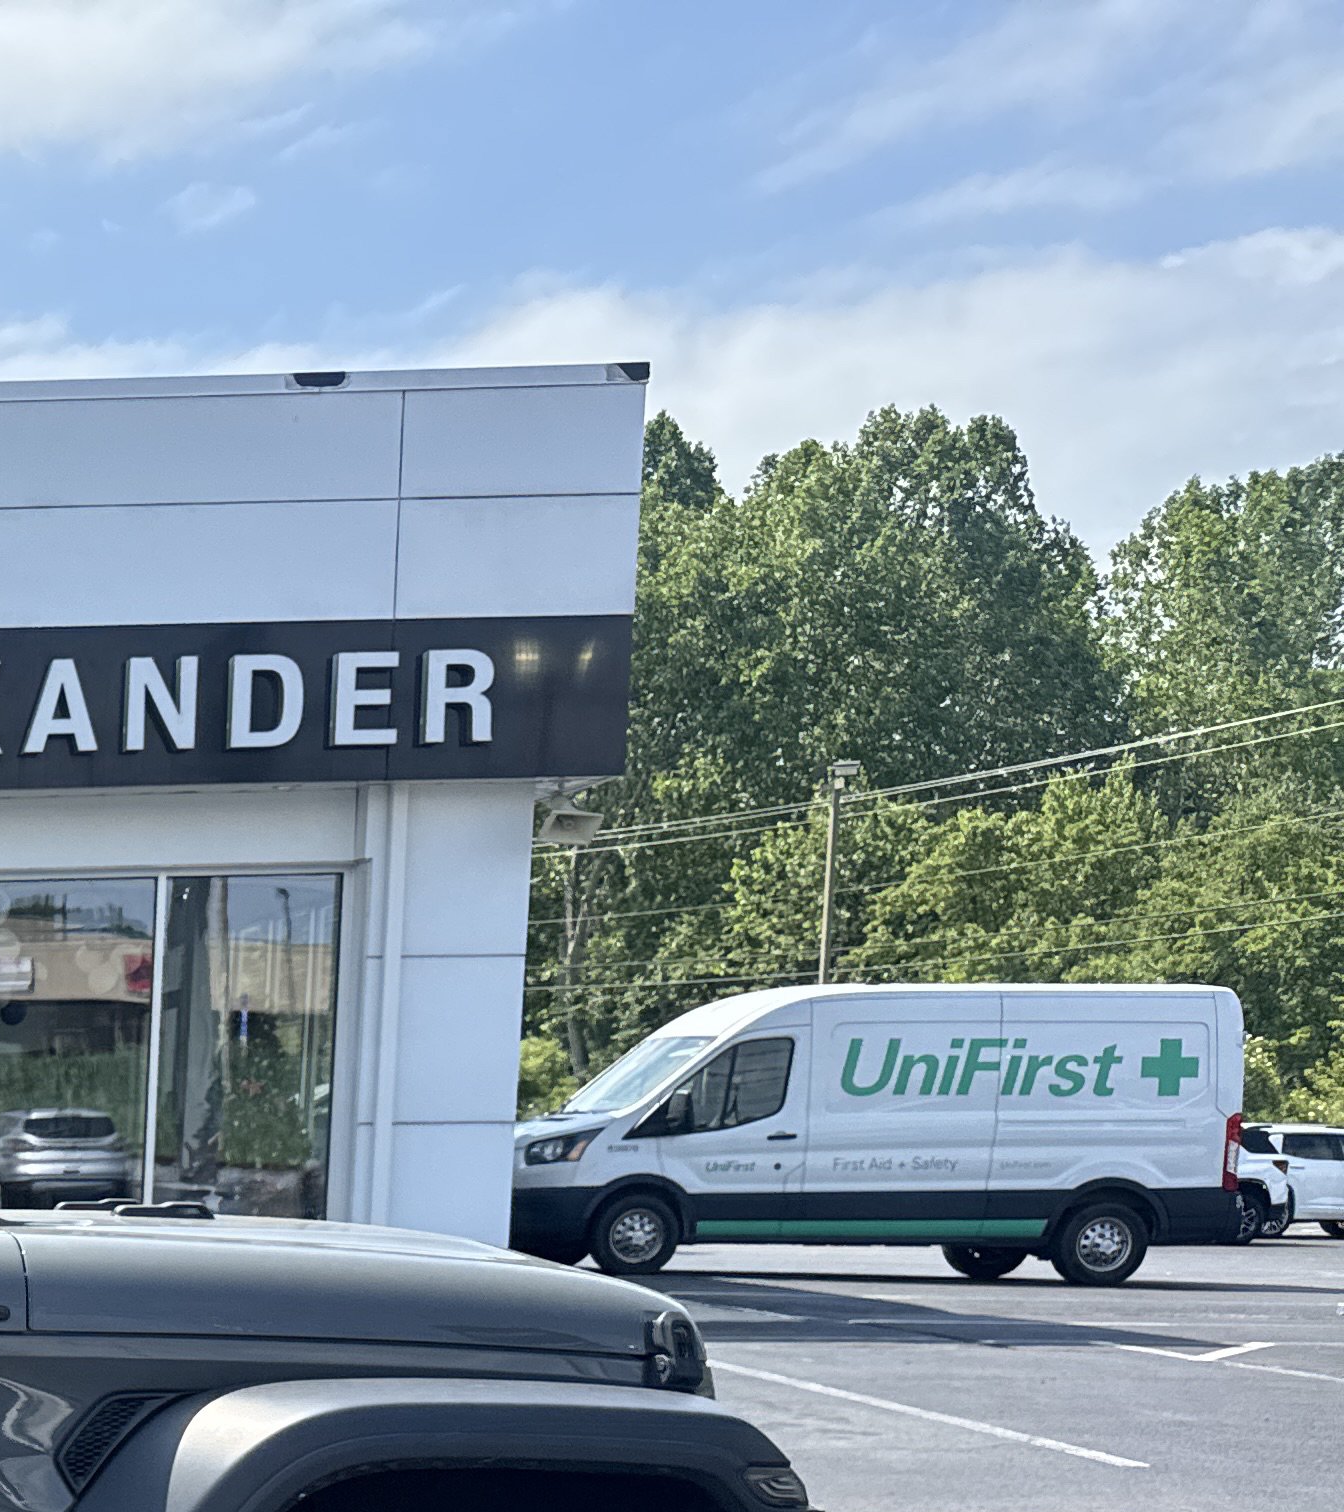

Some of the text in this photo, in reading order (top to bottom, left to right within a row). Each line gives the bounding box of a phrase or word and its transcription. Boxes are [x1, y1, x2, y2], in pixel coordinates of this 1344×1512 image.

[840, 1038, 1123, 1096] UniFirst
[705, 1160, 756, 1172] UniFirst
[832, 1157, 865, 1170] First
[868, 1157, 893, 1170] Aid
[911, 1156, 959, 1172] Safety
